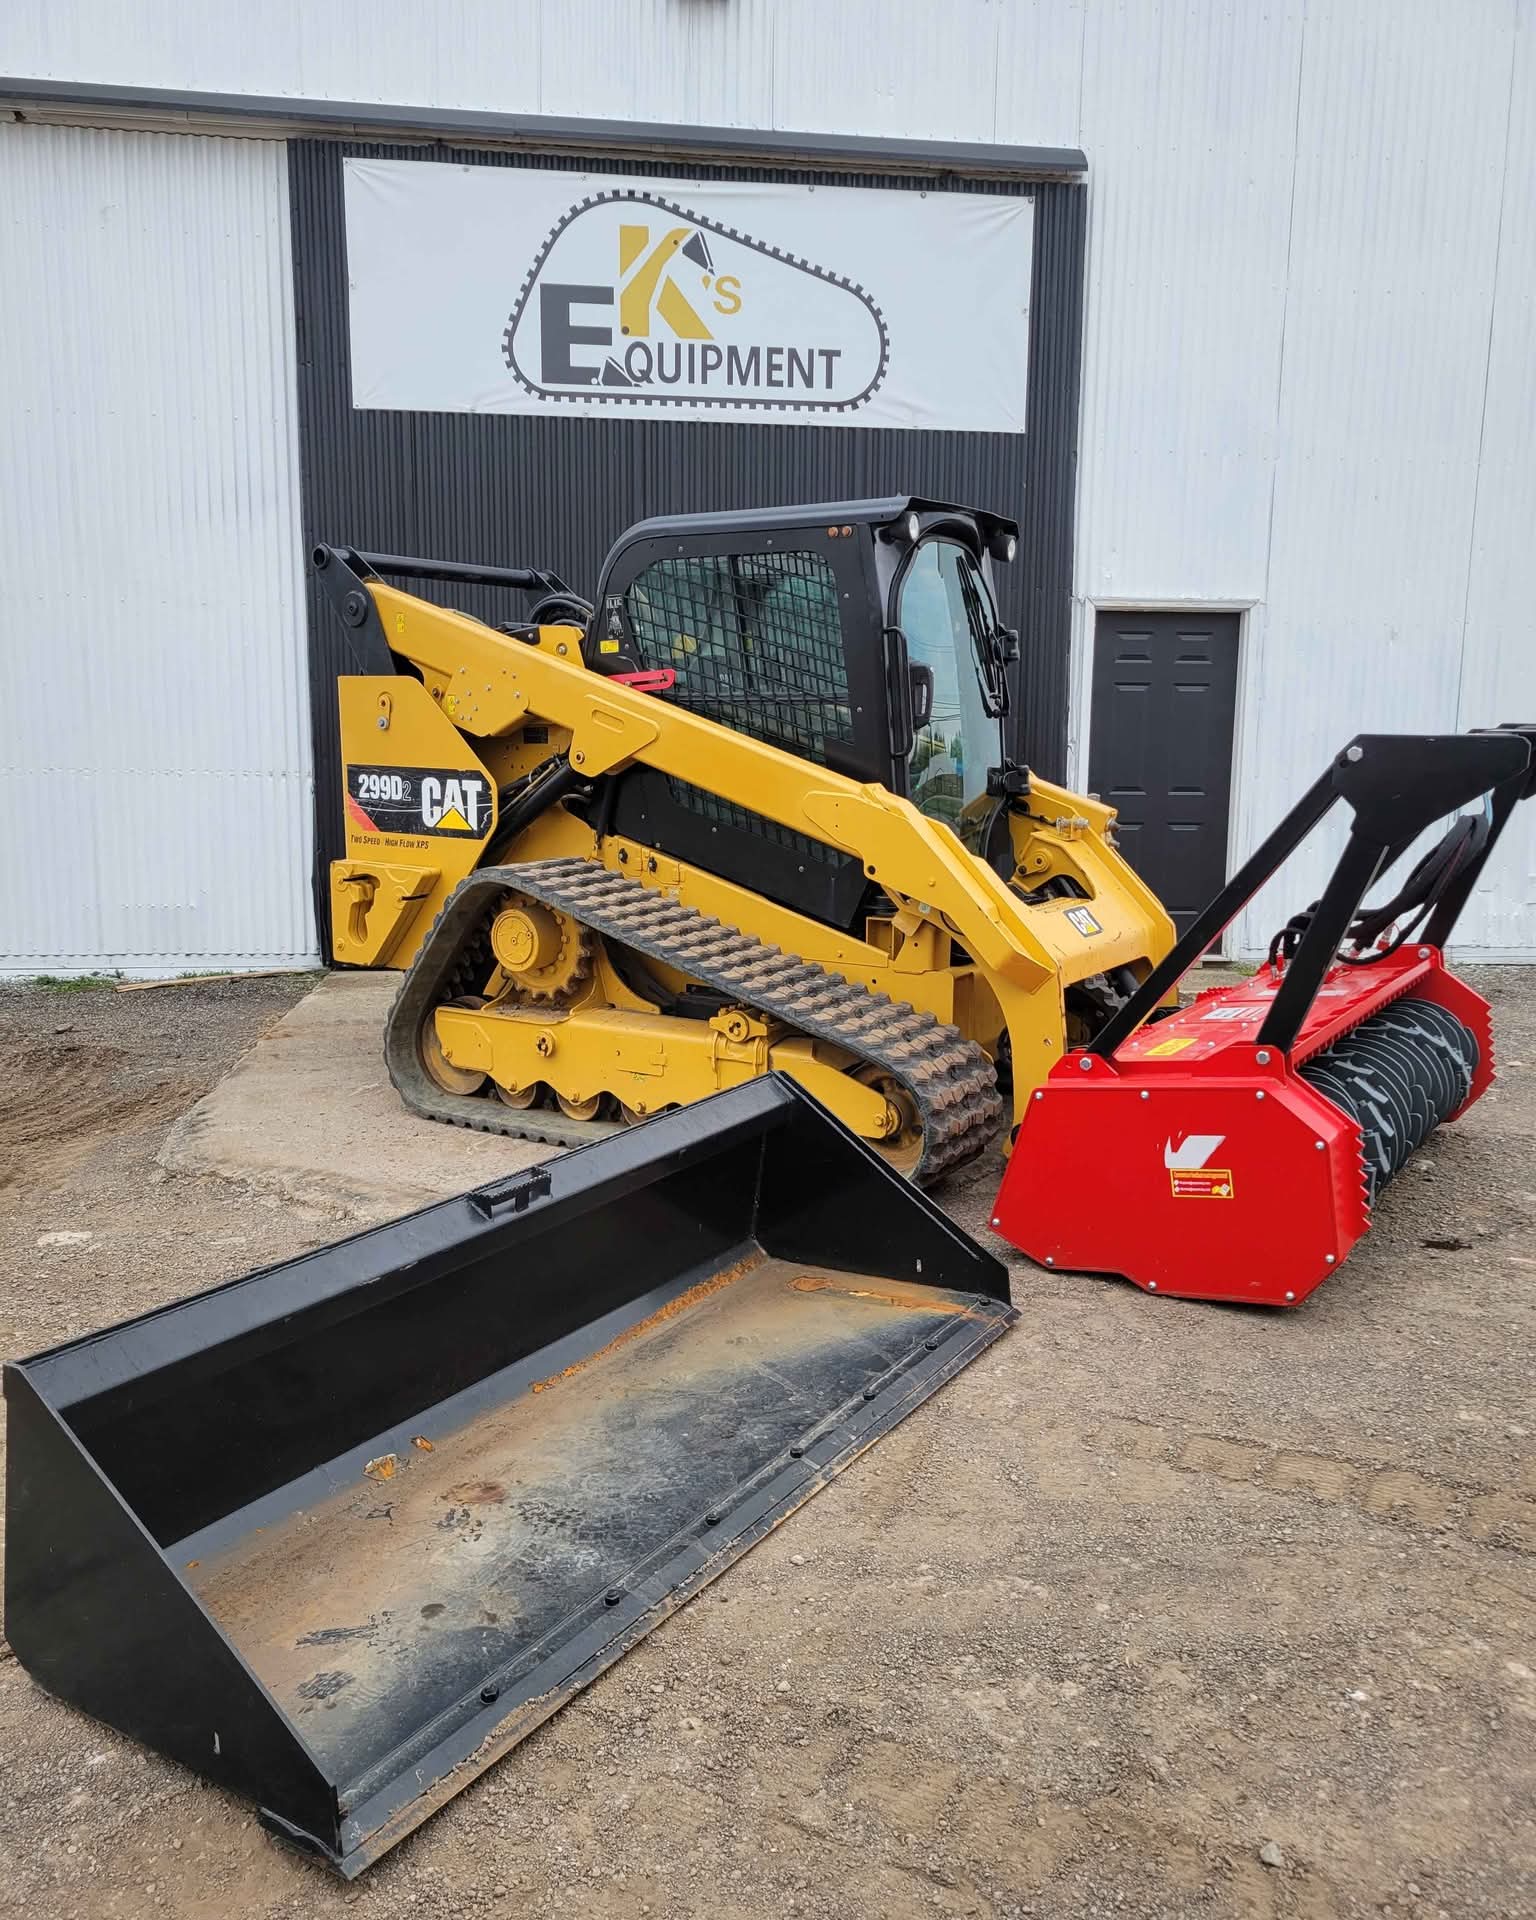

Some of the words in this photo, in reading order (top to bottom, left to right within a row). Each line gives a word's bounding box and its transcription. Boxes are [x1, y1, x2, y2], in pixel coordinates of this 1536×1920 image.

[358, 774, 412, 802] 299D2
[421, 776, 483, 831] CAT
[1067, 908, 1101, 935] CAT
